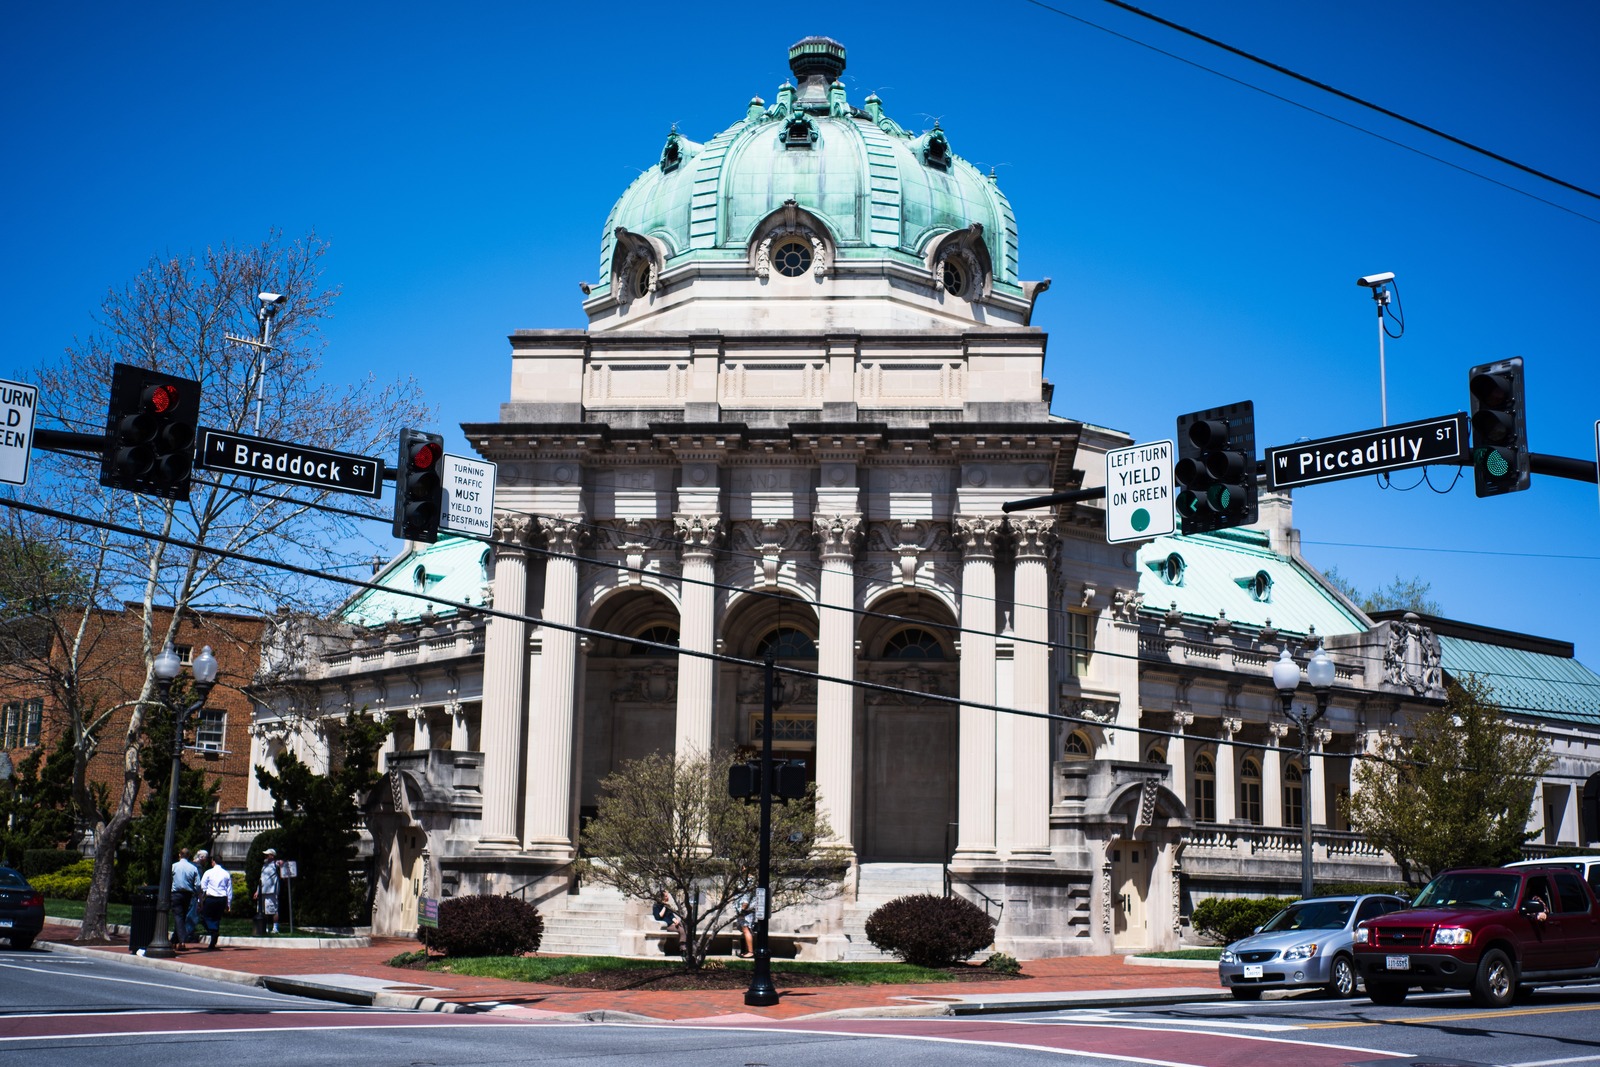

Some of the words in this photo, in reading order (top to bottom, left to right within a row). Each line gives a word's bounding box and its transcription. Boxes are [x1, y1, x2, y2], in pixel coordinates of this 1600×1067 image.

[1111, 452, 1136, 468] LEFT
[1140, 446, 1168, 463] TURN
[1278, 457, 1288, 469] W
[1300, 436, 1423, 475] Piccadilly
[1436, 427, 1452, 441] ST
[216, 440, 225, 452] N
[234, 444, 341, 482] Braddock
[352, 465, 367, 477] ST
[454, 463, 485, 477] TURNING
[1119, 466, 1161, 487] YIELD
[454, 475, 483, 489] TRAFFIC
[875, 473, 946, 489] BRARY
[455, 488, 480, 502] MUST
[1113, 492, 1127, 506] ON
[1132, 485, 1168, 503] GREEN
[450, 502, 472, 513] YIELD
[474, 506, 483, 515] TO
[441, 512, 489, 529] PEDESTRIANS
